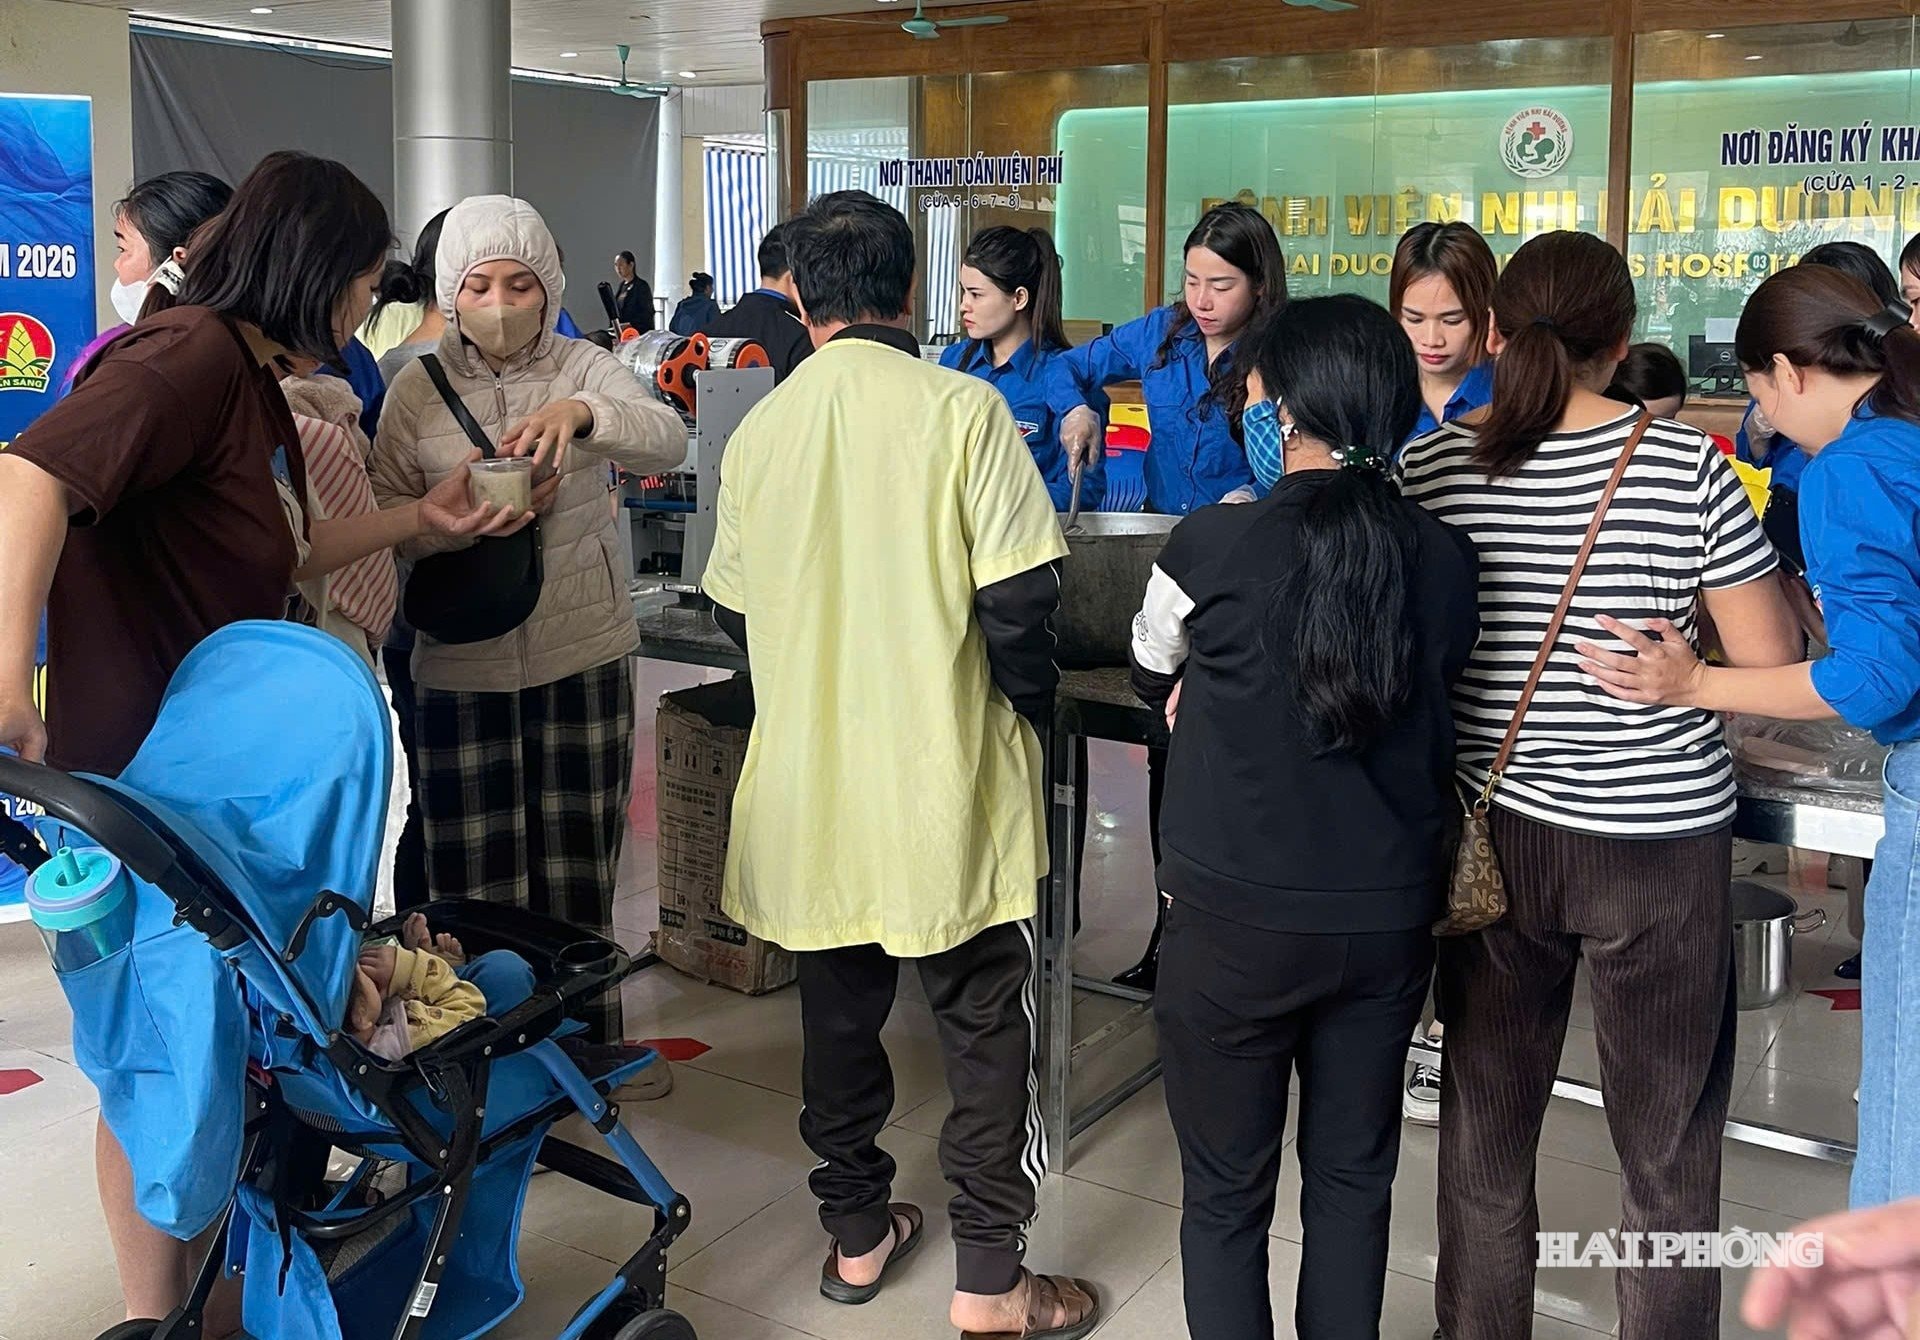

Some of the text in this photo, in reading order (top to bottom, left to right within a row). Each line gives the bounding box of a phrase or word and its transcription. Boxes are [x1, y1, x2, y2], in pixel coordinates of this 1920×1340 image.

[1721, 130, 1761, 165] NƠI
[1768, 123, 1833, 164] ĐĂNG
[1840, 121, 1873, 162] KÝ
[879, 150, 1064, 191] NƠI THANH TOÁN VIỆN PHÍ
[1804, 171, 1856, 195] (CỬA
[1863, 175, 1872, 190] 1
[1894, 174, 1905, 190] 2
[919, 191, 953, 211] (CỬA
[954, 195, 961, 208] 5
[970, 195, 979, 208] 6
[990, 195, 997, 207] 7
[1008, 193, 1021, 211] 8)
[1482, 190, 1577, 235] NHI
[17, 243, 77, 279] 2026
[1752, 255, 1768, 269] 03
